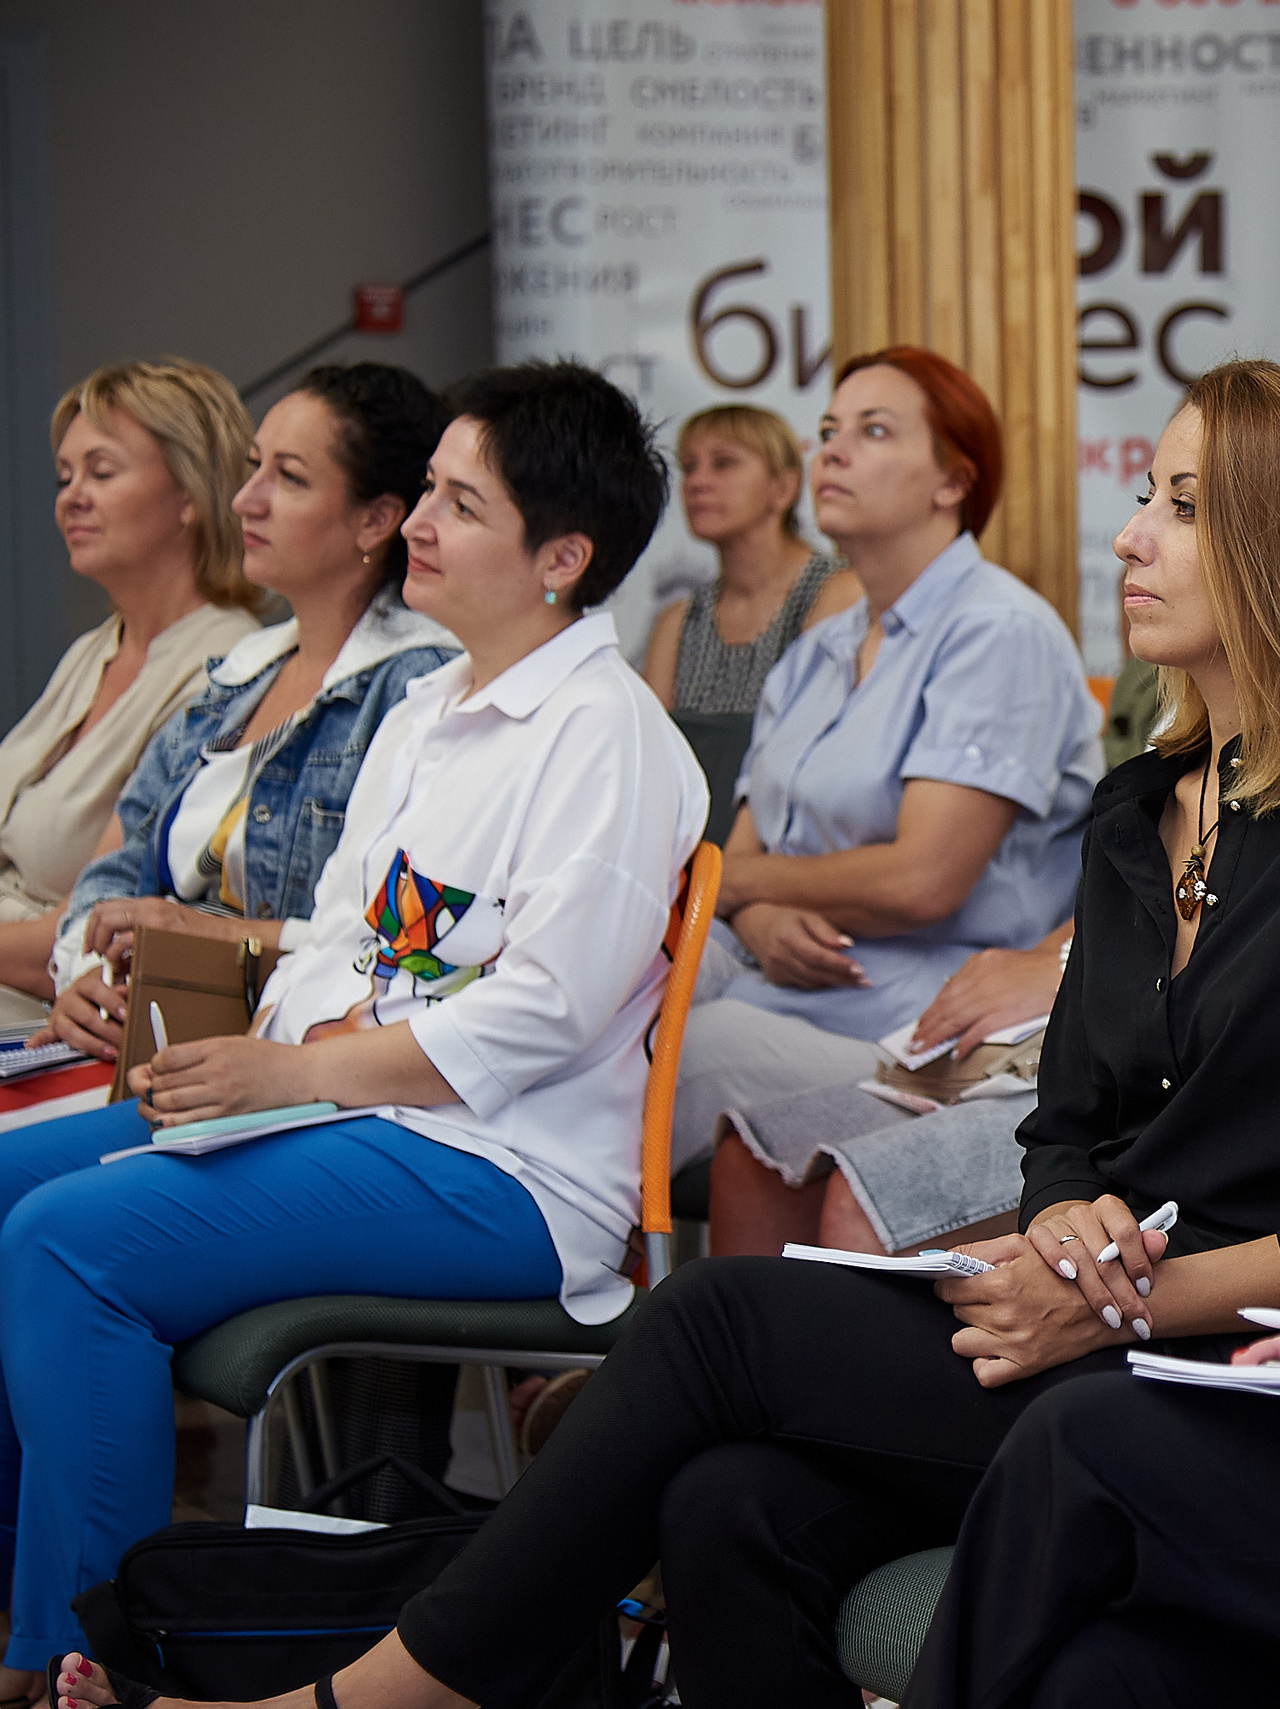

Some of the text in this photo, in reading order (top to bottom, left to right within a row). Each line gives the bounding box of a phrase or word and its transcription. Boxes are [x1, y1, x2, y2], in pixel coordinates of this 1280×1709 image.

[568, 17, 696, 64] ЦЕЛЬ
[1074, 150, 1225, 281] ой
[498, 261, 639, 297] ЖЕНИЯ
